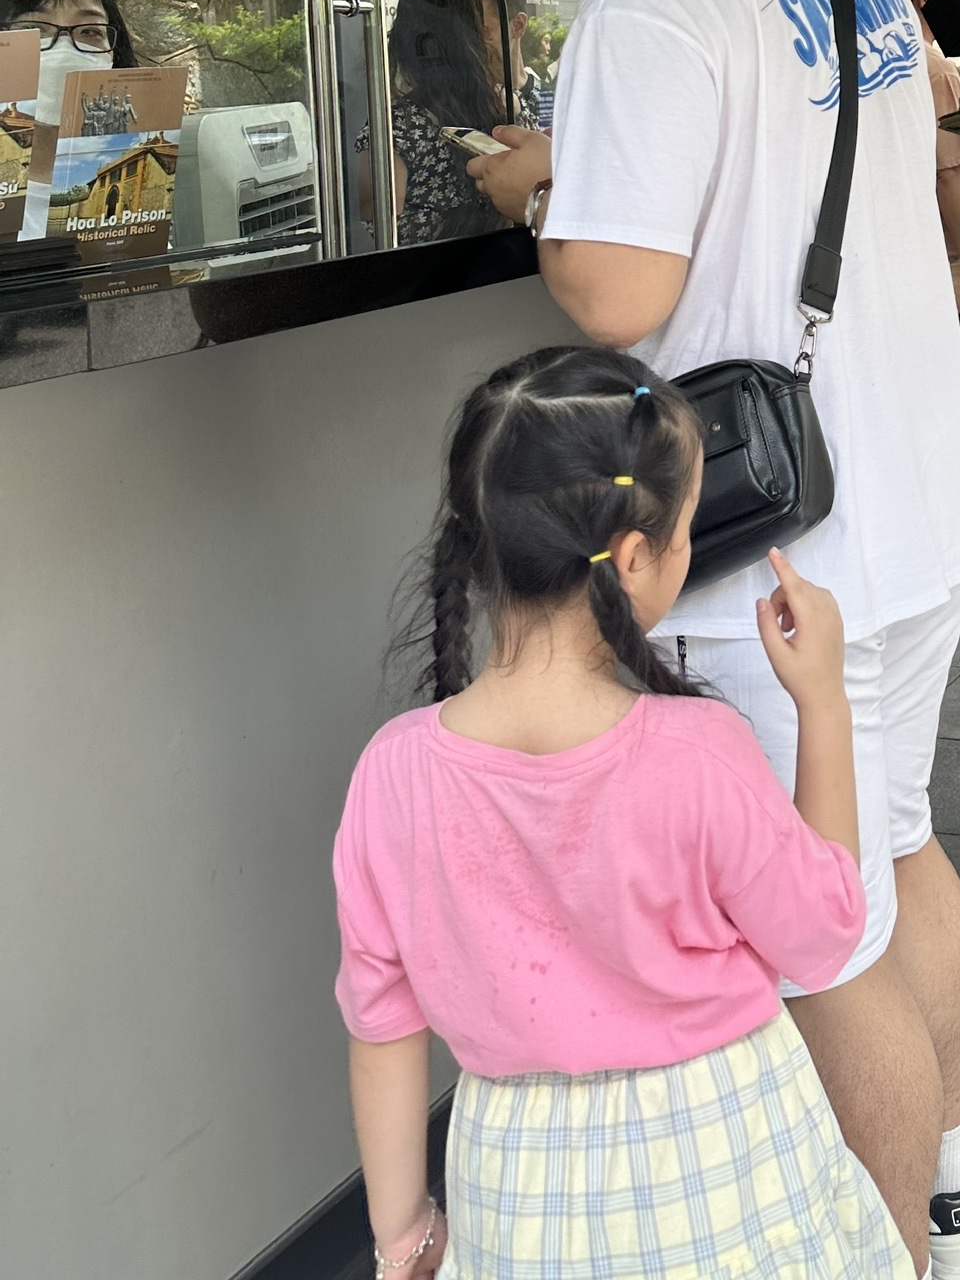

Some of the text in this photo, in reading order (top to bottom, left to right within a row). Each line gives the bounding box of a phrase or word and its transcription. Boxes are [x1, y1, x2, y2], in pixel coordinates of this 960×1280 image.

[66, 208, 166, 232] Hoa Lo Prison
[77, 223, 156, 242] Historical Relic
